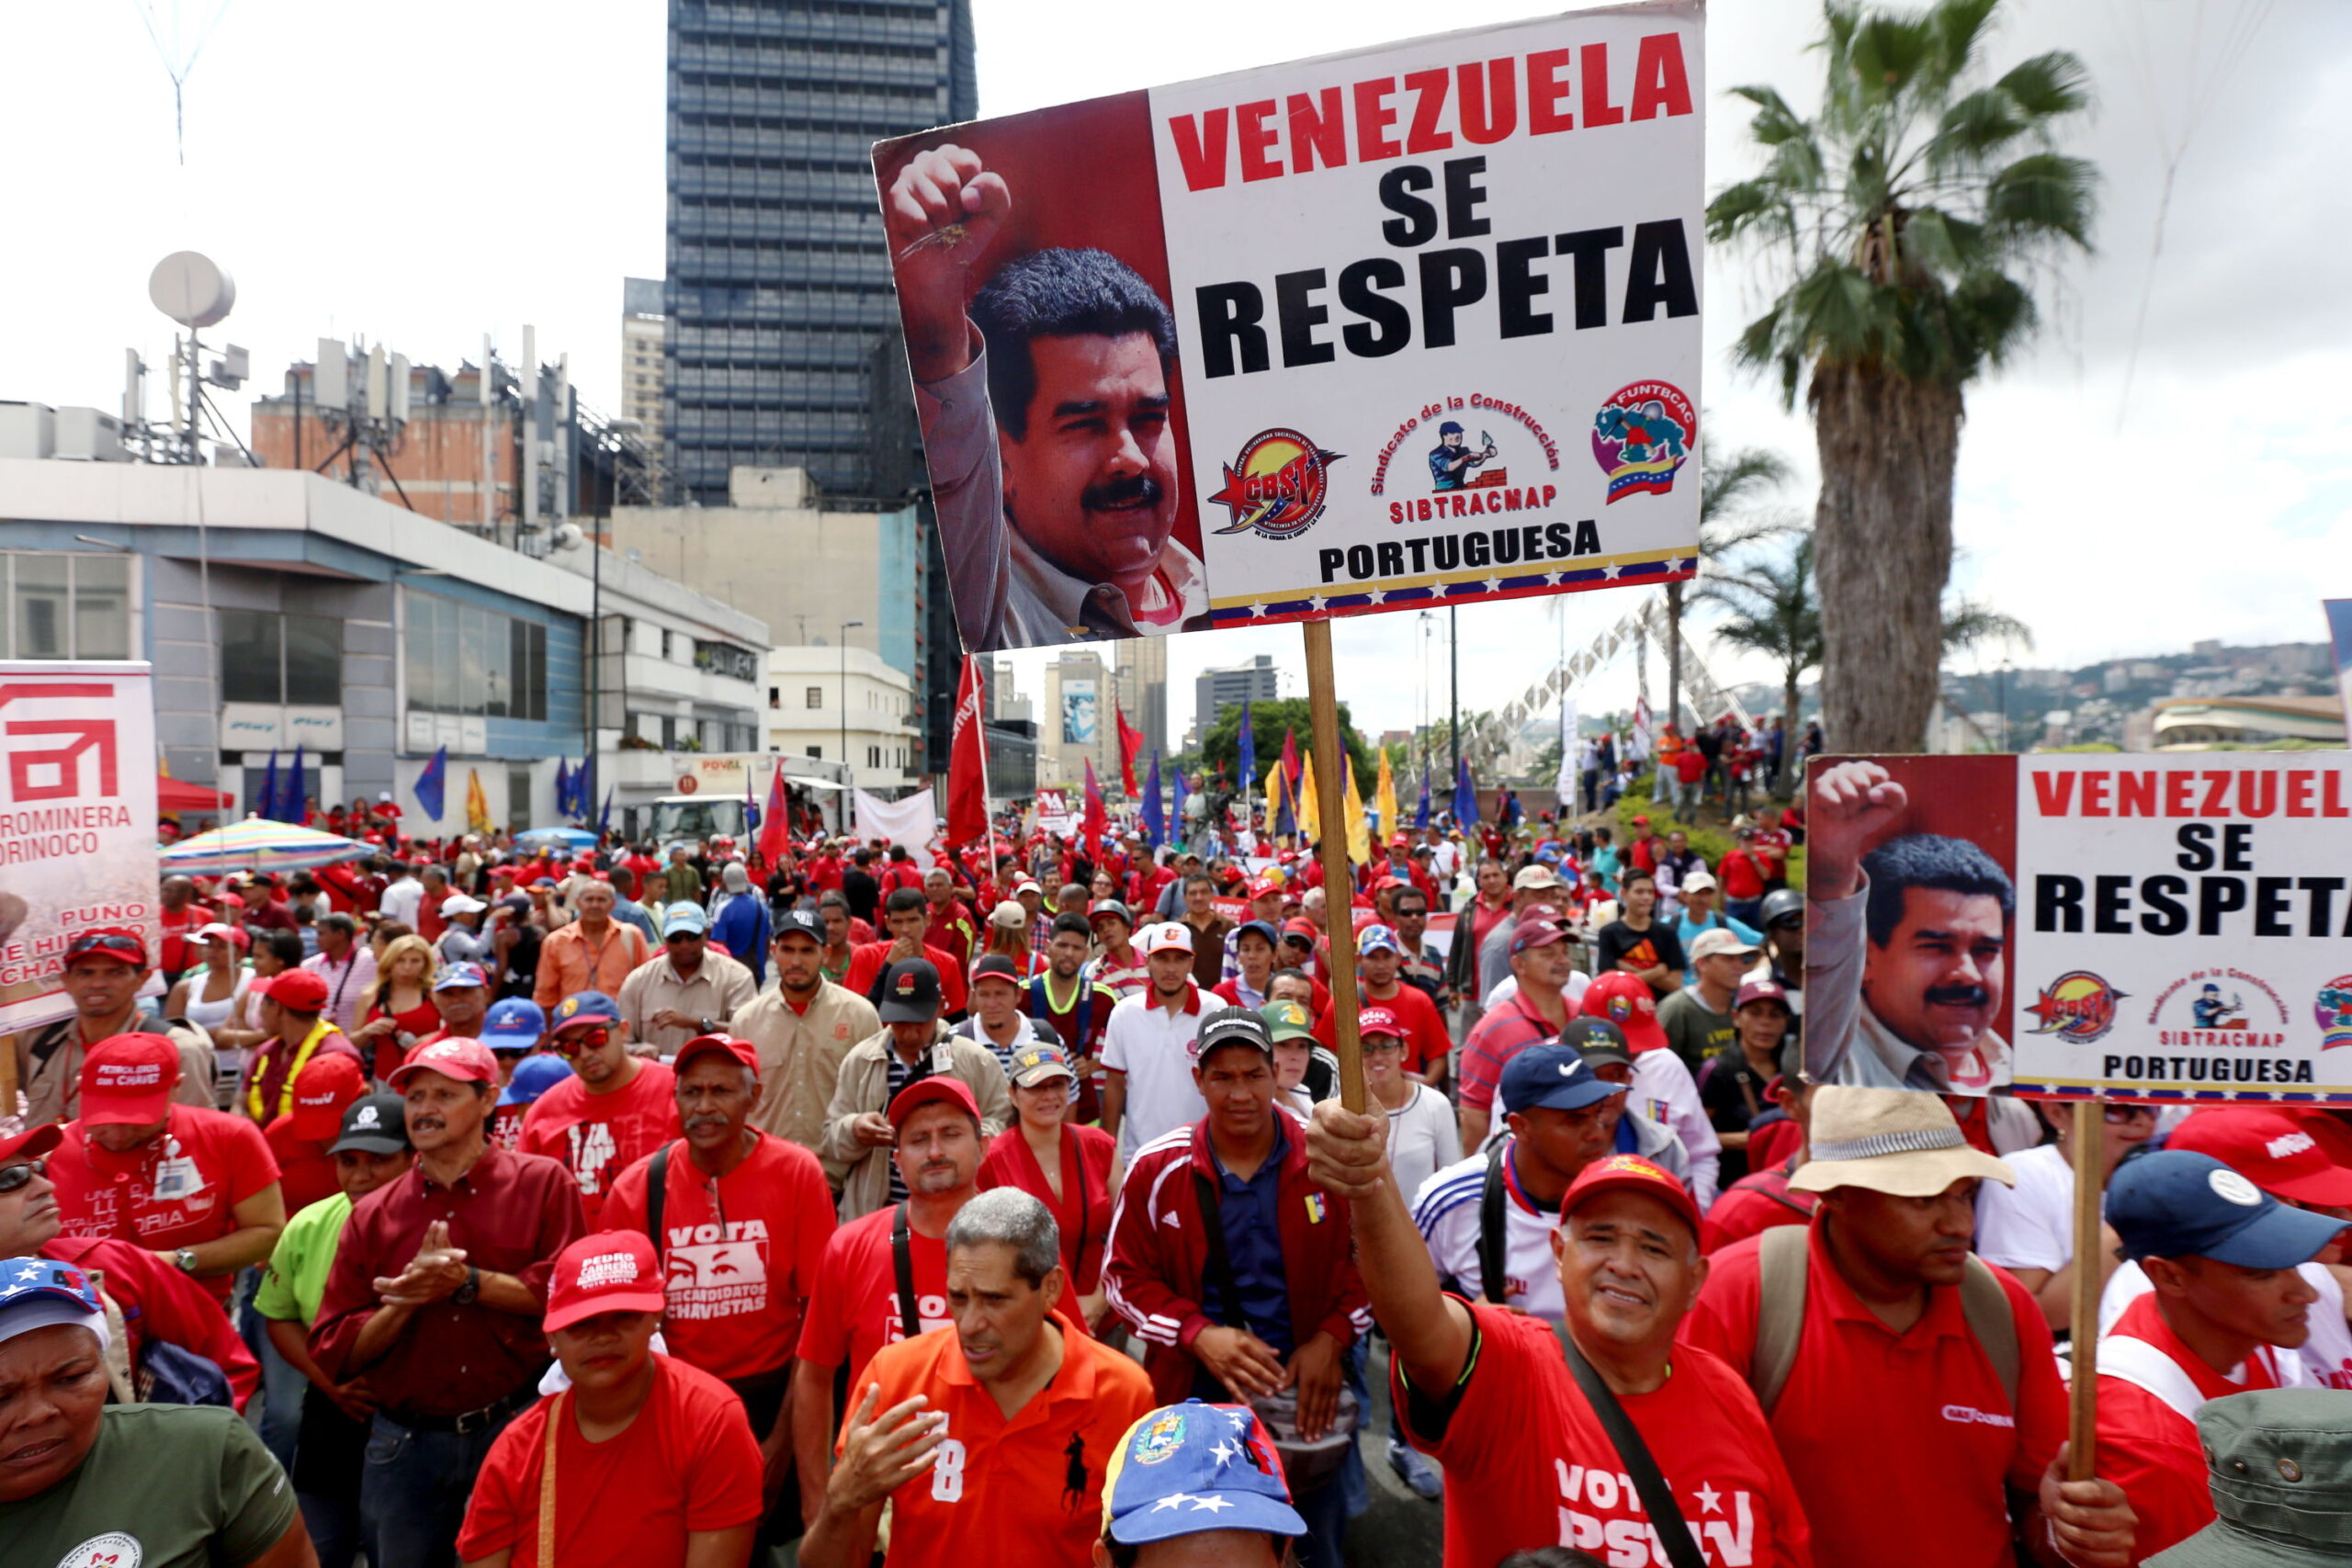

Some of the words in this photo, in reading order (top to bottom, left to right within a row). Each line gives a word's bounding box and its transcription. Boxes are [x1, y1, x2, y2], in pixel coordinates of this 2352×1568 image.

[1169, 32, 1693, 192] VENEZUELA
[1378, 155, 1490, 248] SE
[1195, 218, 1699, 379] RESPETA
[1371, 417, 1418, 495] Sindicato
[1420, 403, 1442, 422] de
[1447, 396, 1464, 410] la
[1470, 393, 1560, 471] Construcción
[1245, 450, 1309, 506] CBST
[1389, 485, 1556, 524] SIBTRACMAP
[1318, 520, 1602, 583] PORTUGUESA
[2031, 771, 2349, 818] VENEZUEL
[2177, 823, 2254, 872] SE
[2035, 874, 2352, 937] RESPET
[0, 943, 23, 962] E
[2159, 1031, 2285, 1047] SIBTRACMAP
[2104, 1055, 2313, 1083] PORTUGUESA
[668, 1219, 768, 1247] VOTA
[582, 1253, 635, 1268] PEDRO
[665, 1296, 766, 1320] CHAVISTAS
[683, 1283, 767, 1302] CANDIDATOS
[1555, 1458, 1672, 1513] VOT
